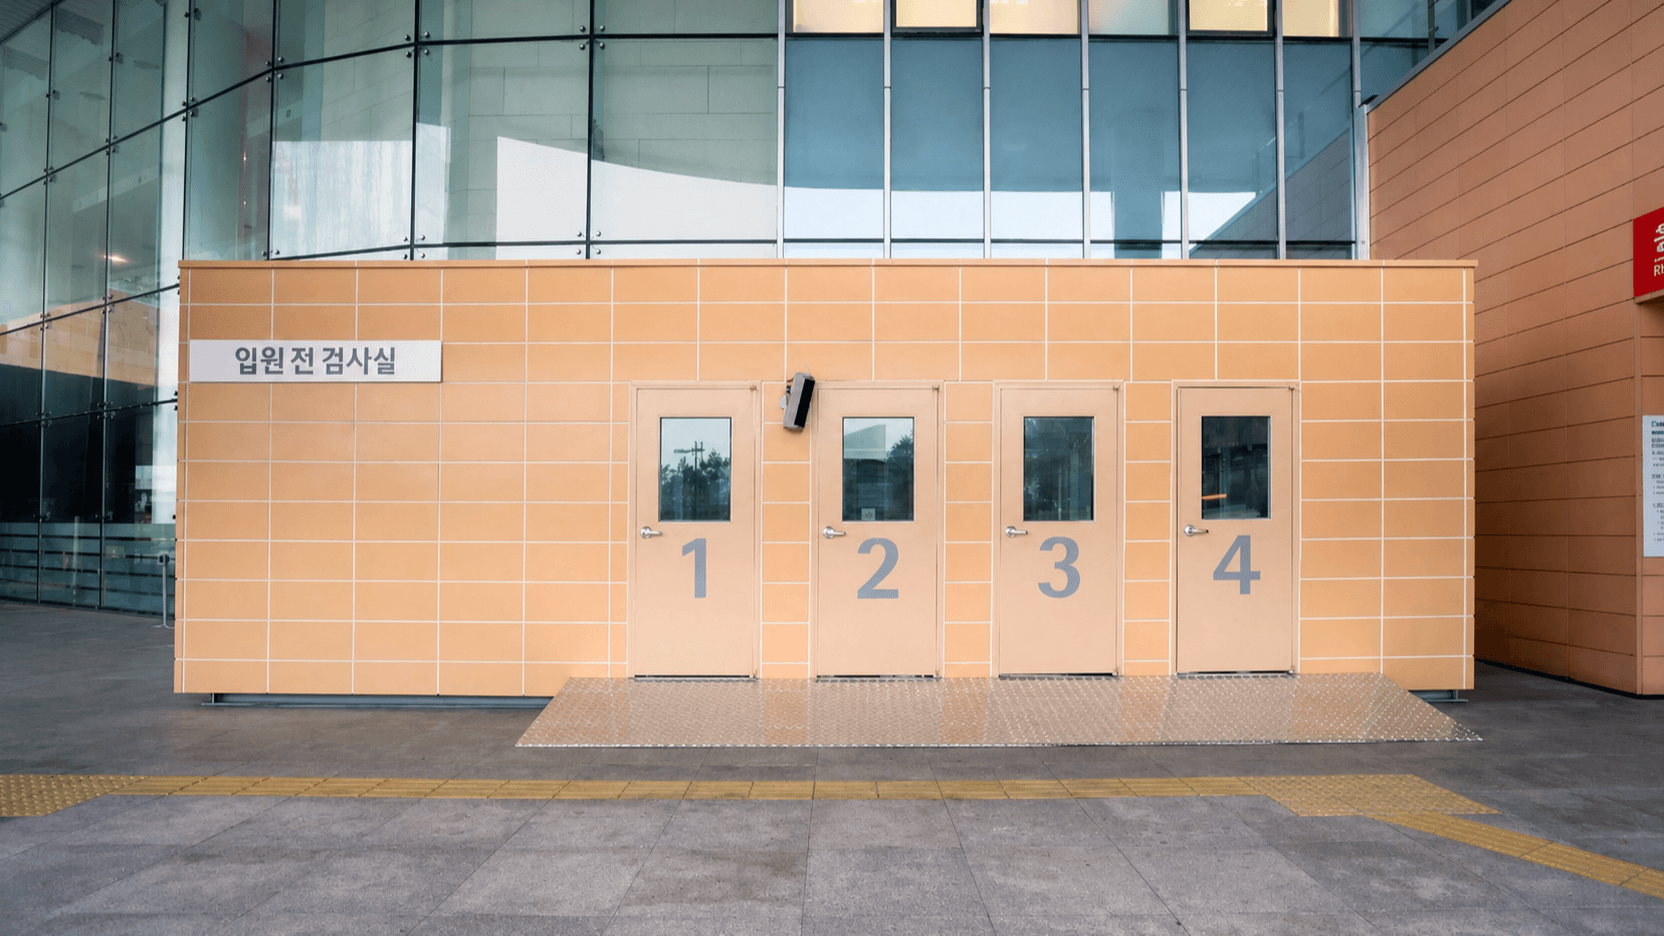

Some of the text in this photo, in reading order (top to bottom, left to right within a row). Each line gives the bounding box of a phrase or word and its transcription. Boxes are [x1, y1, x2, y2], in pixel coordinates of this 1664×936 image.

[235, 347, 395, 375] 입원 전 검사실
[682, 538, 707, 598] 1
[857, 537, 899, 599] 2
[1038, 536, 1081, 598] 3
[1213, 535, 1261, 595] 4
